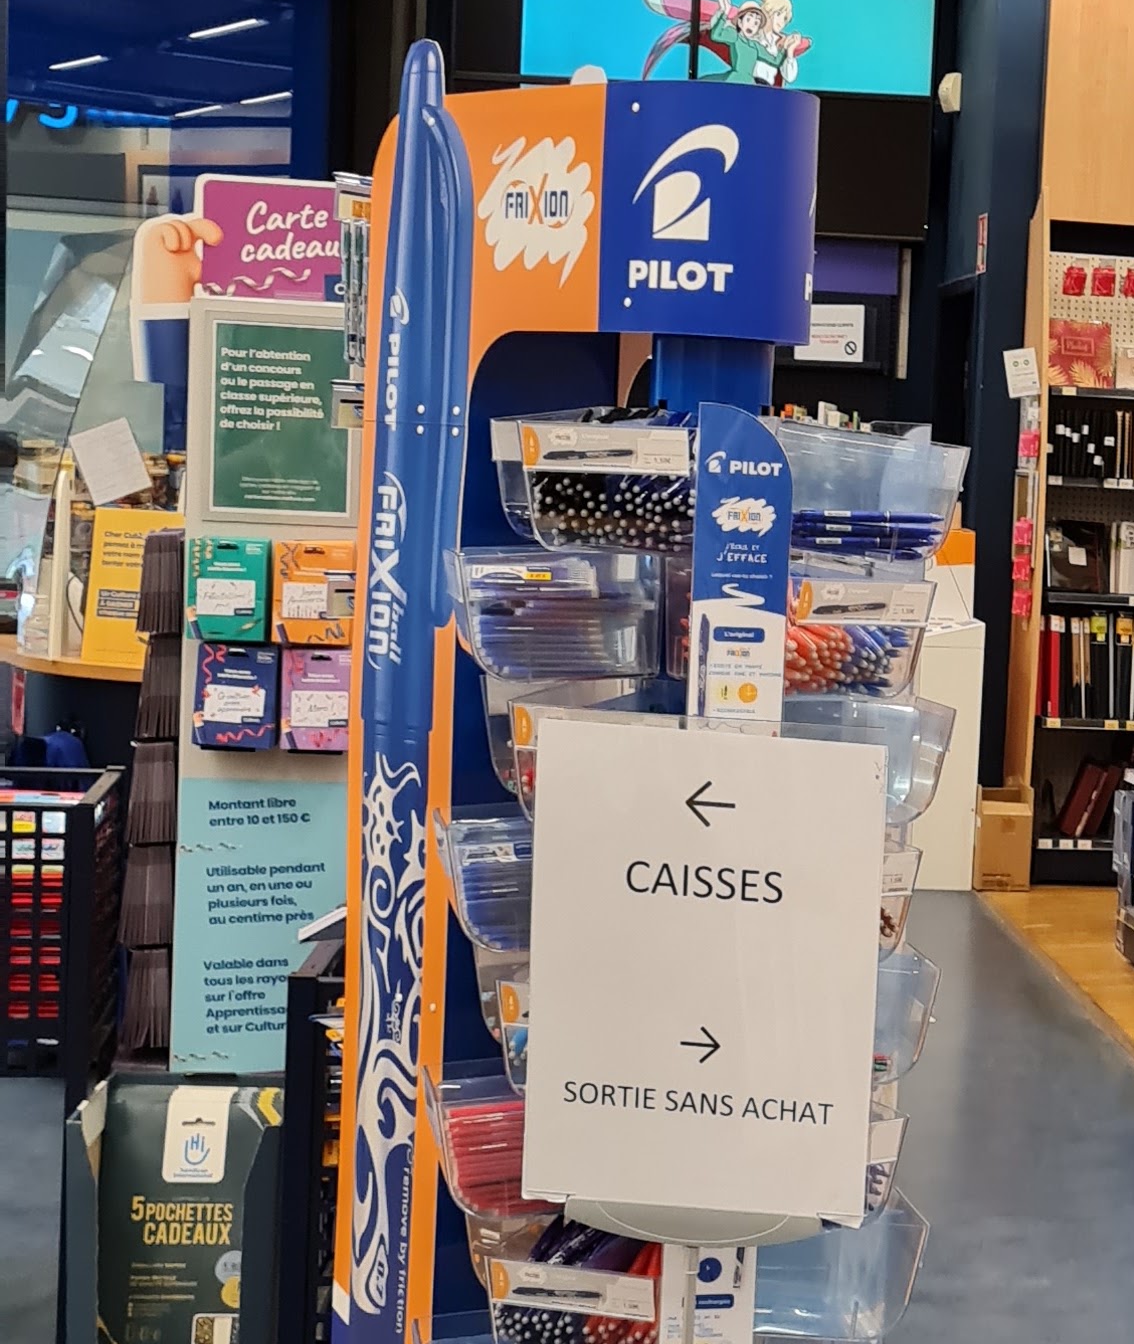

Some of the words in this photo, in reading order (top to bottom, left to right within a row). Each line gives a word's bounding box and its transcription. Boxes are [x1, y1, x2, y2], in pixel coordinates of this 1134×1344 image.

[246, 201, 329, 235] Carte
[240, 232, 340, 262] cadeau
[628, 260, 734, 293] PILOT
[221, 347, 247, 358] Pour
[249, 348, 311, 362] l'obtention
[220, 362, 247, 372] d'un
[248, 364, 302, 375] concours
[220, 378, 236, 386] ou
[237, 377, 248, 386] le
[249, 378, 299, 391] passage
[300, 381, 315, 390] en
[386, 333, 400, 432] PILOT
[220, 391, 257, 401] classe
[220, 405, 252, 415] offrez
[253, 407, 265, 416] la
[266, 407, 325, 419] possibilité
[219, 419, 235, 429] de
[236, 419, 275, 430] choisir
[730, 460, 782, 477] PILOT
[716, 552, 767, 563] J'EFFACE
[208, 798, 265, 810] Montant
[267, 797, 297, 809] libre
[209, 815, 244, 827] entre
[247, 814, 260, 825] 10
[262, 814, 275, 824] et
[277, 813, 298, 824] 150
[300, 812, 311, 823] €
[206, 865, 267, 877] Utilisable
[269, 862, 325, 877] pendant
[207, 884, 225, 893] un
[227, 883, 247, 894] an,
[249, 882, 266, 891] en
[268, 880, 294, 890] une
[296, 879, 312, 889] ou
[626, 859, 784, 905] CAISSES
[208, 897, 268, 911] plusieurs
[270, 895, 298, 908] fois,
[208, 916, 227, 925] au
[228, 913, 283, 924] centime
[285, 910, 314, 925] près
[204, 958, 254, 970] Valable
[256, 957, 289, 968] dans
[204, 975, 233, 986] tous
[235, 975, 254, 986] les
[205, 992, 226, 1002] sur
[228, 990, 265, 1002] l'offre
[206, 1025, 220, 1035] et
[222, 1023, 243, 1033] sur
[563, 1081, 657, 1110] SORTIE
[665, 1090, 734, 1118] SANS
[742, 1098, 834, 1126] ACHAT
[131, 1196, 145, 1221] 5
[145, 1203, 234, 1222] POCHETTES
[401, 1167, 411, 1238] remove
[142, 1222, 231, 1246] CADEAUX
[397, 1242, 408, 1264] by
[395, 1269, 406, 1334] friction
